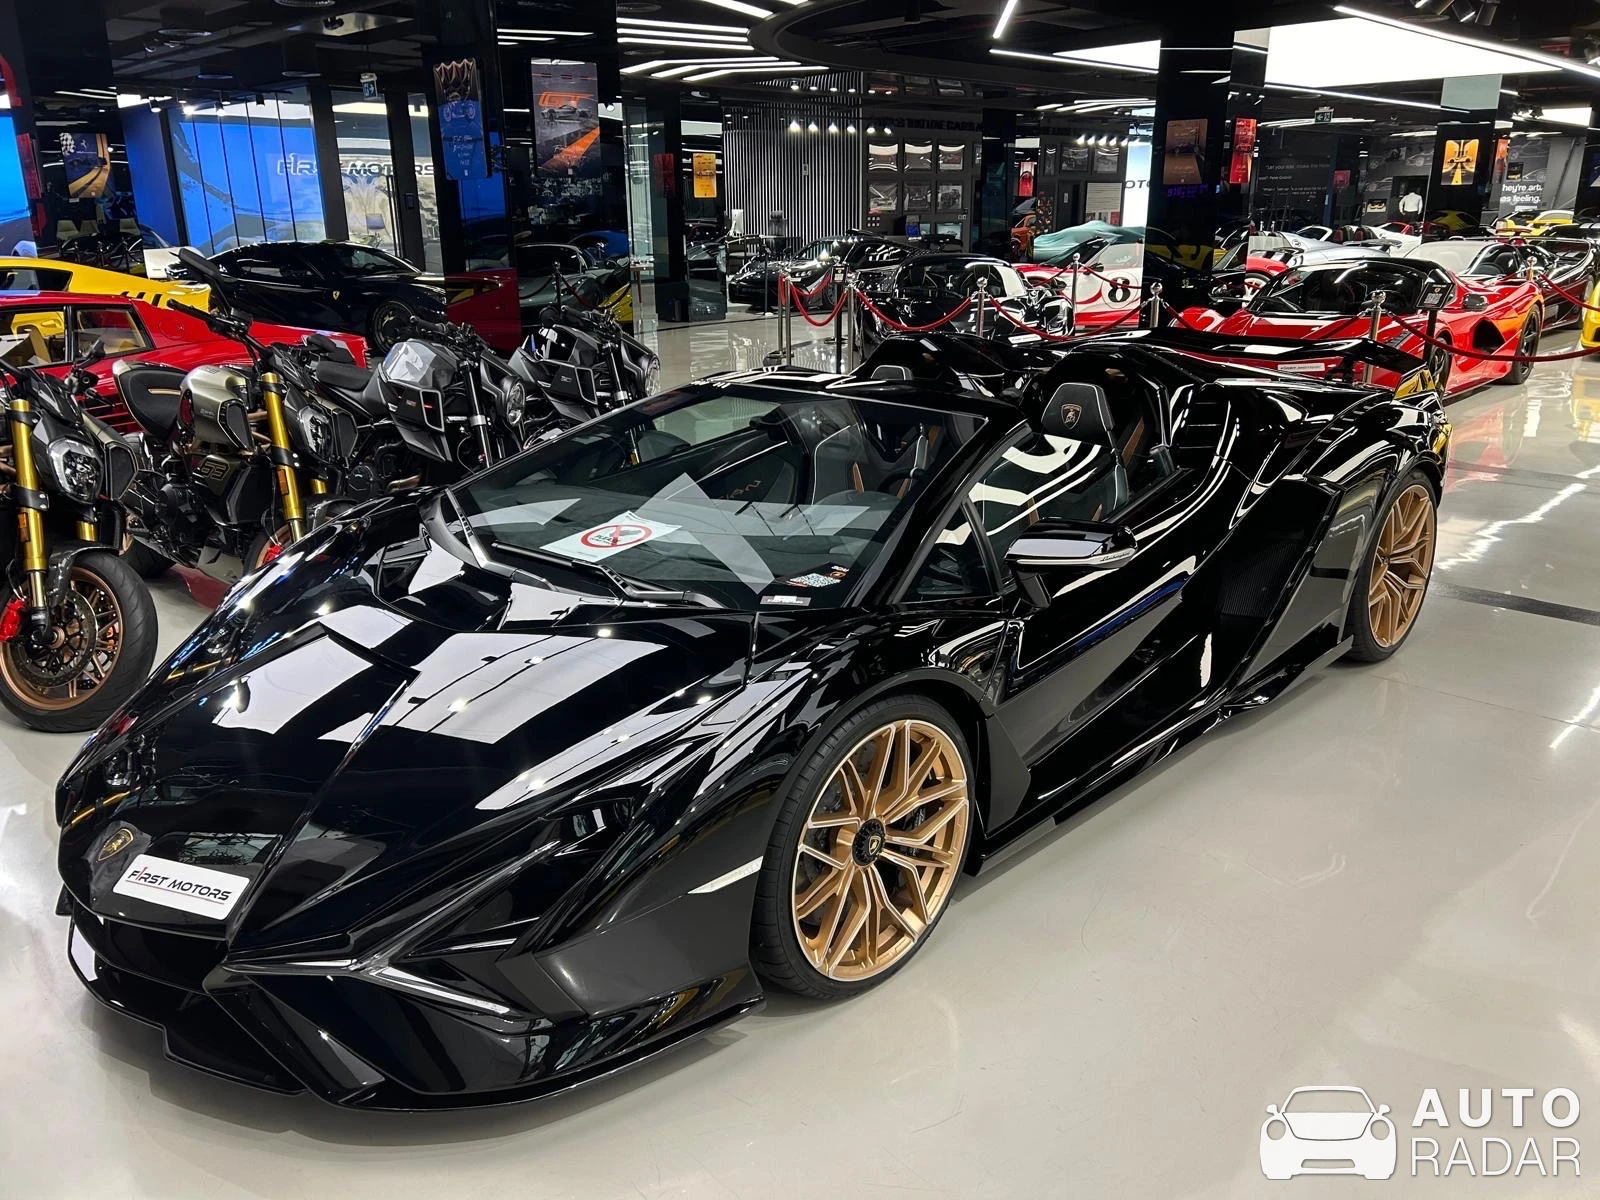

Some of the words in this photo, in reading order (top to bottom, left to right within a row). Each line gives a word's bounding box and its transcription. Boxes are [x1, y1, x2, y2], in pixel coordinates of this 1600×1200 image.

[348, 162, 435, 177] MOTRS
[1512, 194, 1541, 204] feeling.
[1108, 277, 1131, 303] 8
[127, 867, 169, 886] FIRST
[168, 880, 232, 901] MOTORS
